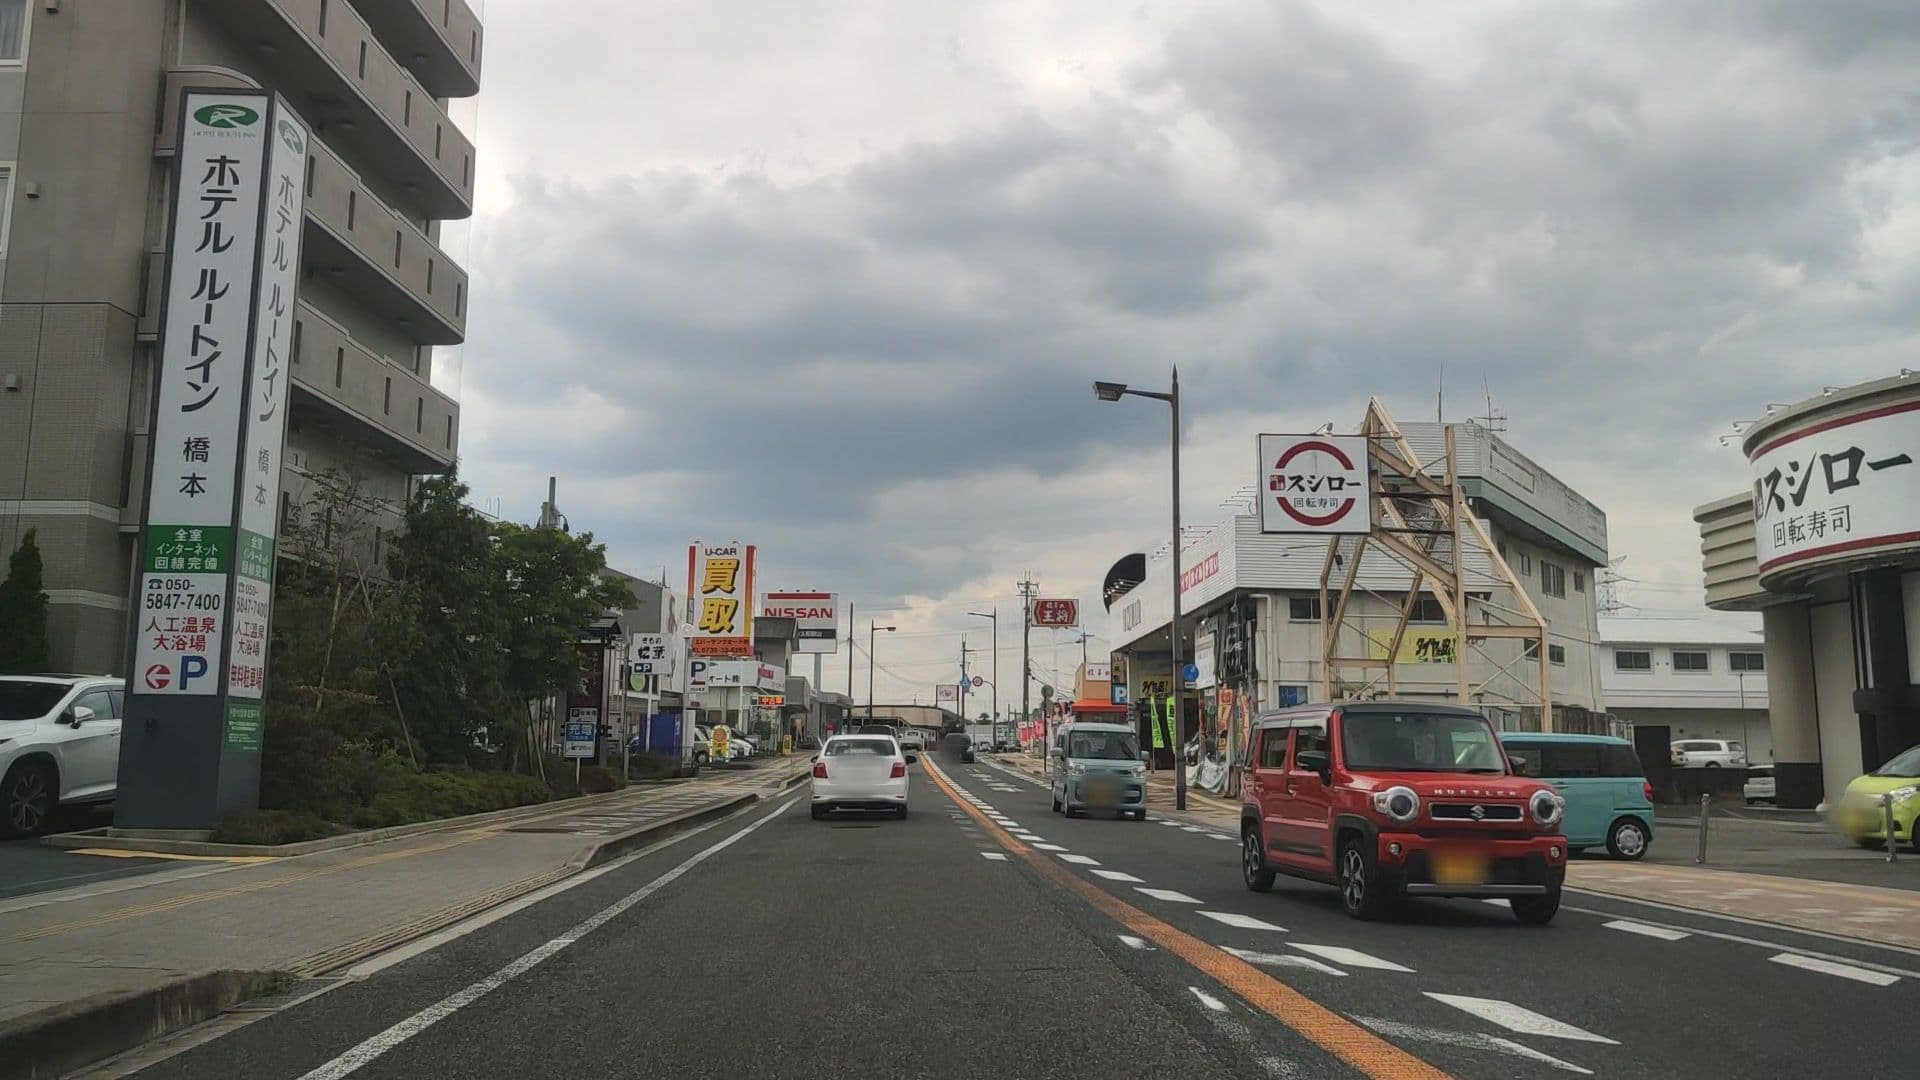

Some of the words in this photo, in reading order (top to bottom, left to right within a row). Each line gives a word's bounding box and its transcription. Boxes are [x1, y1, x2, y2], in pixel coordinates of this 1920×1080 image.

[195, 155, 240, 253] ホテル
[272, 174, 294, 272] ホテル
[181, 268, 230, 413] ルートイン
[259, 282, 285, 422] ルートイン
[1286, 474, 1361, 492] スシロー
[1764, 446, 1913, 521] スシロー
[1294, 497, 1339, 508] 回転寿司
[174, 528, 203, 542] 全室
[1773, 504, 1851, 549] 回転寿司
[156, 543, 218, 556] インターネット
[704, 547, 737, 556] U-CAR
[155, 557, 218, 570] 回線完備
[146, 593, 220, 610] 5847-7400
[698, 558, 740, 634] 買取
[764, 608, 833, 619] NISSAN
[1042, 610, 1068, 622] 王将
[145, 616, 216, 634] 人工温泉
[152, 634, 207, 652] 大浴場
[179, 656, 208, 690] P
[643, 664, 650, 673] P
[690, 661, 706, 678] P
